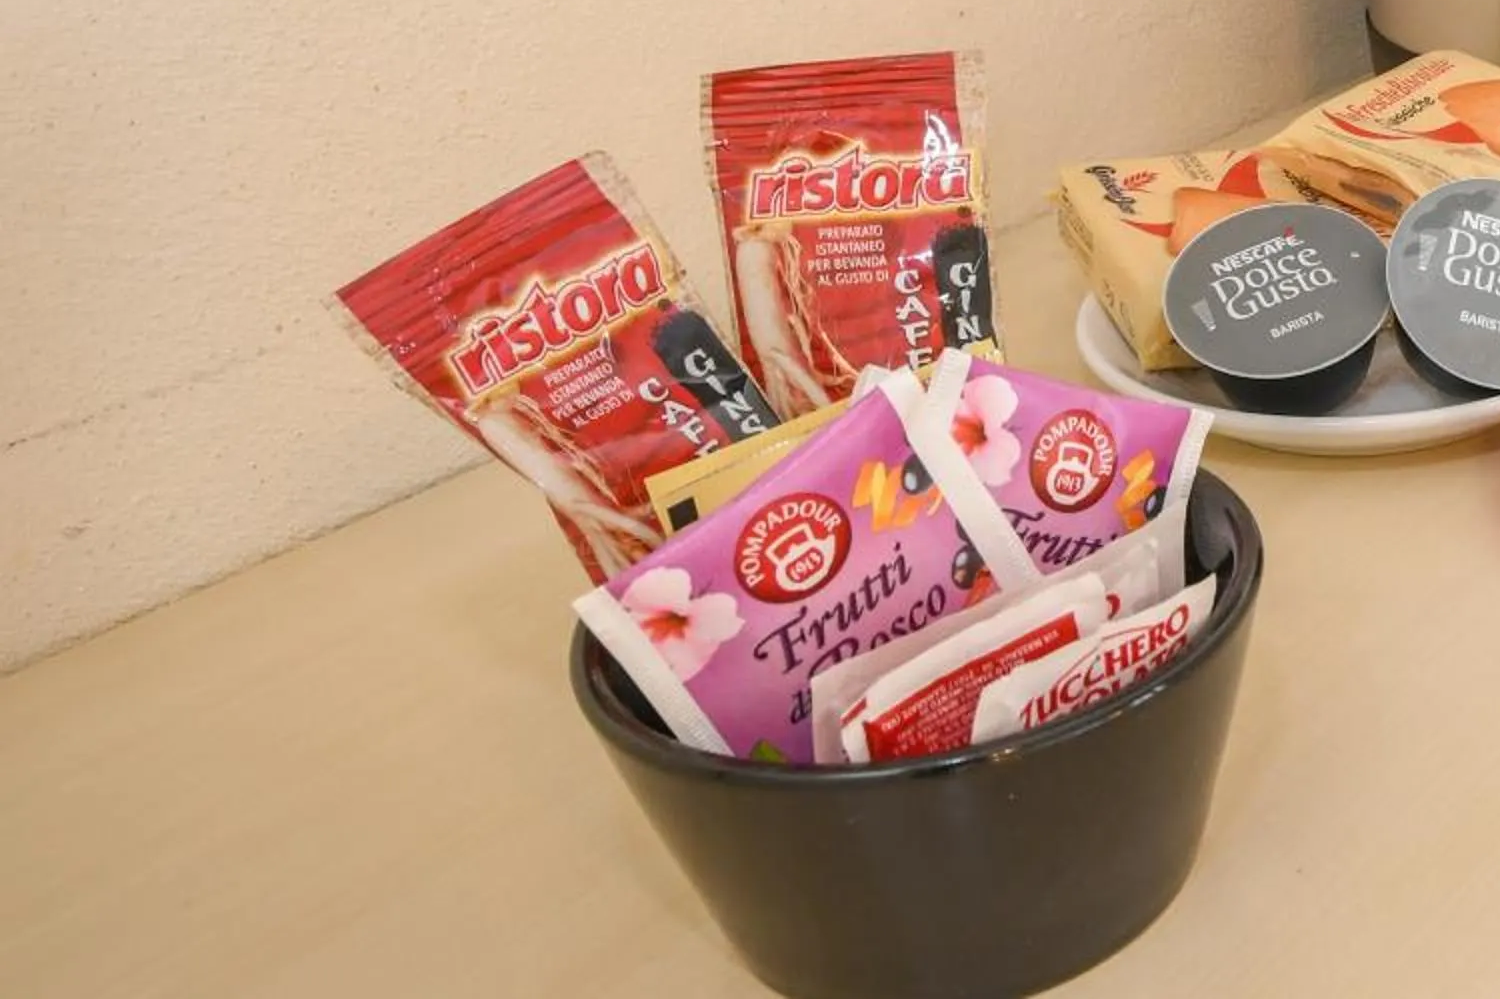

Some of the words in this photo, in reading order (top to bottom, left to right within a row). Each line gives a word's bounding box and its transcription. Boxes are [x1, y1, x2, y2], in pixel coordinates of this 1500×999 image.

[750, 145, 973, 219] ristora
[815, 239, 886, 256] ISTANTANEO
[817, 224, 884, 240] PREPARATO
[807, 258, 832, 272] PER
[834, 254, 888, 270] BEVANDA
[817, 274, 832, 286] AL
[835, 271, 873, 285] GUSTO
[876, 270, 889, 282] DI
[1210, 248, 1322, 303] Dolce
[1225, 267, 1336, 320] Gusto
[451, 243, 667, 395] ristora
[1269, 310, 1325, 339] BARISTA
[549, 362, 614, 405] ISTANTANEO
[551, 402, 577, 421] PER
[573, 376, 628, 413] BEVANDA
[572, 412, 589, 429] AL
[586, 395, 622, 422] GUSTO
[618, 389, 636, 405] DI
[1033, 415, 1114, 477] POMPADOUR
[740, 499, 841, 588] POMPADOUR
[789, 547, 823, 579] 1913
[753, 542, 912, 675] Frutti
